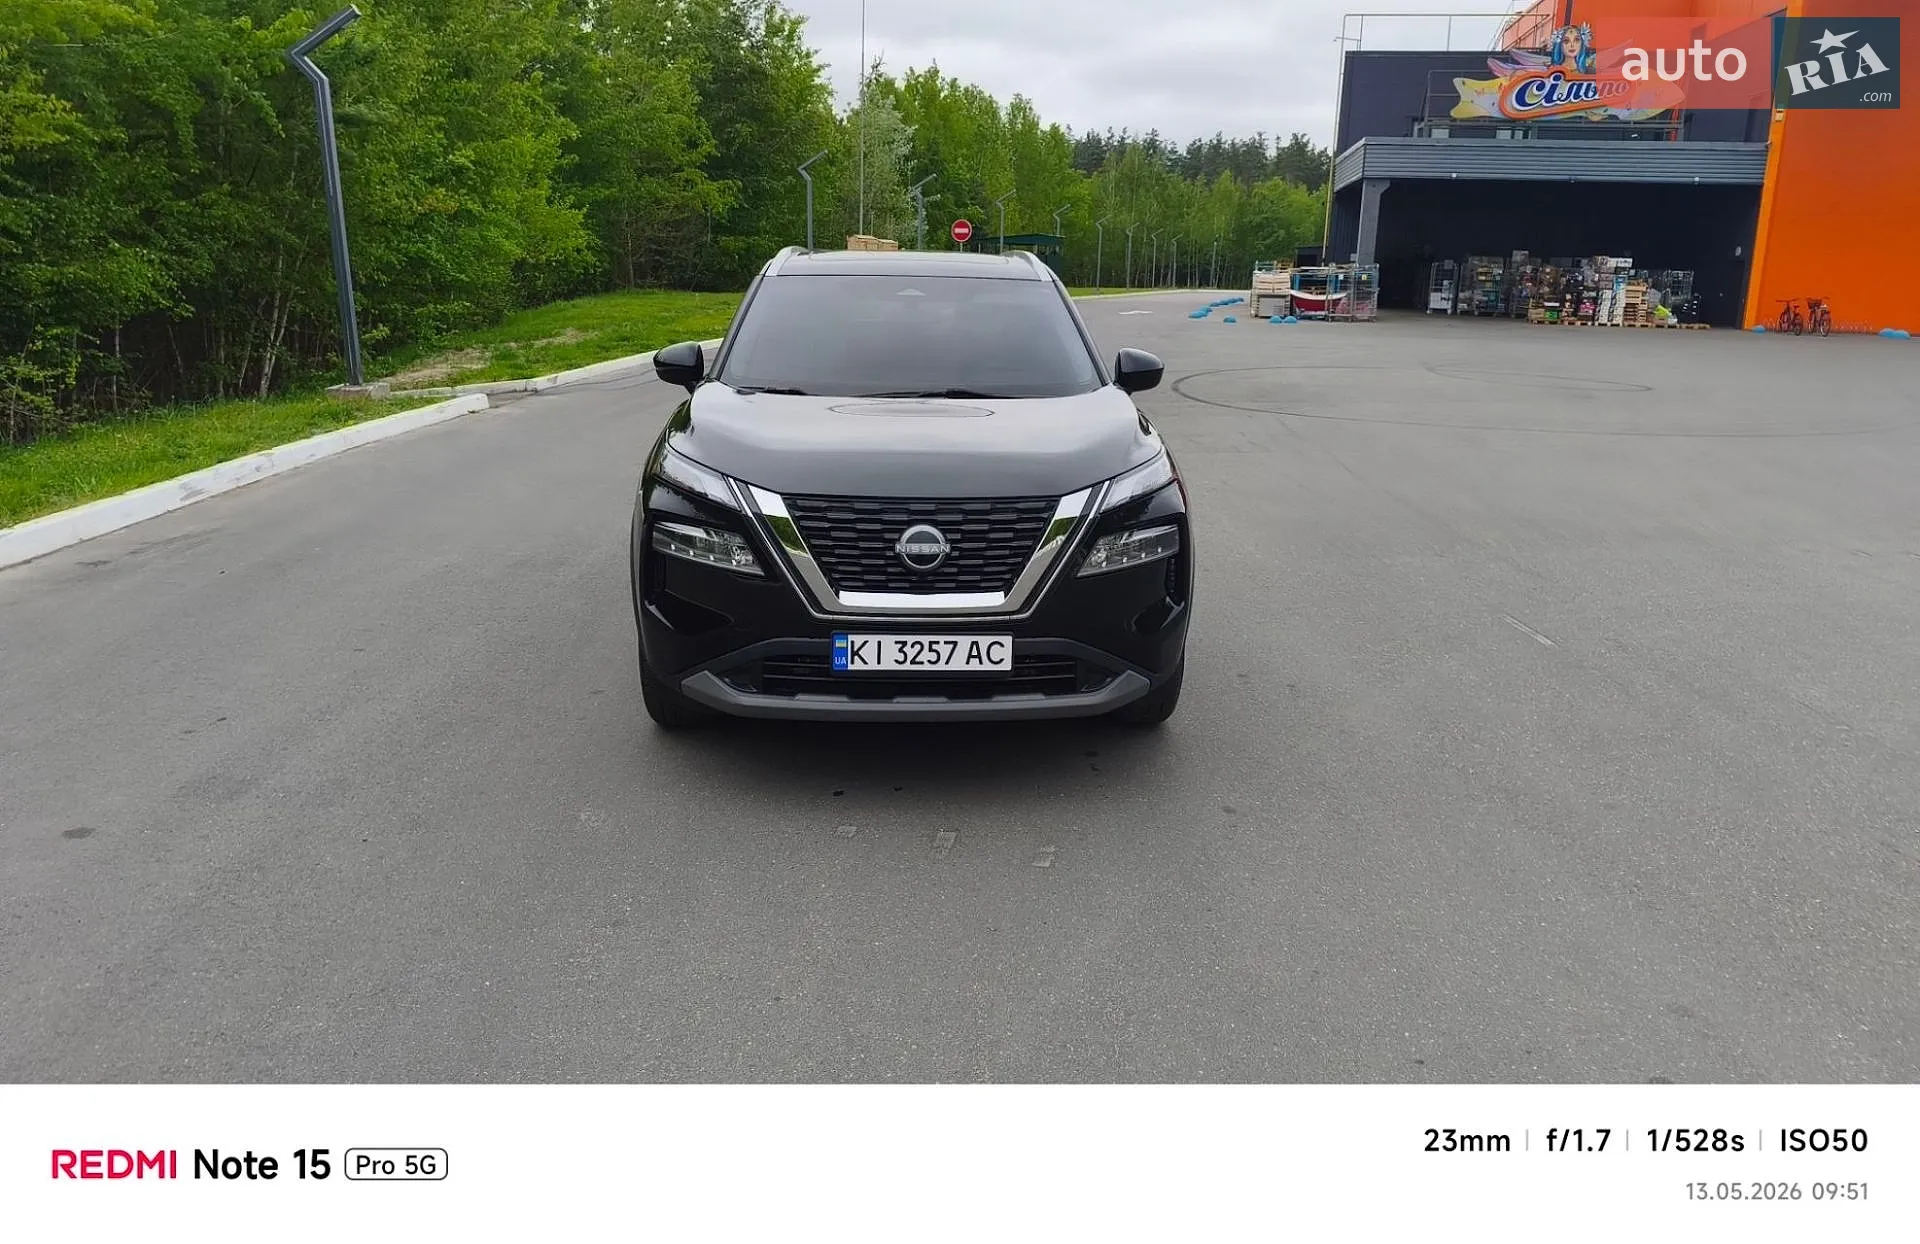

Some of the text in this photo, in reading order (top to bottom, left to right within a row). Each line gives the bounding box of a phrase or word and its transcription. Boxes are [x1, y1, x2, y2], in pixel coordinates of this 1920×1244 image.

[1514, 71, 1630, 110] Сільпо
[896, 544, 950, 554] NISSAN
[834, 656, 848, 666] UA
[850, 640, 1005, 666] KI 3257 AC
